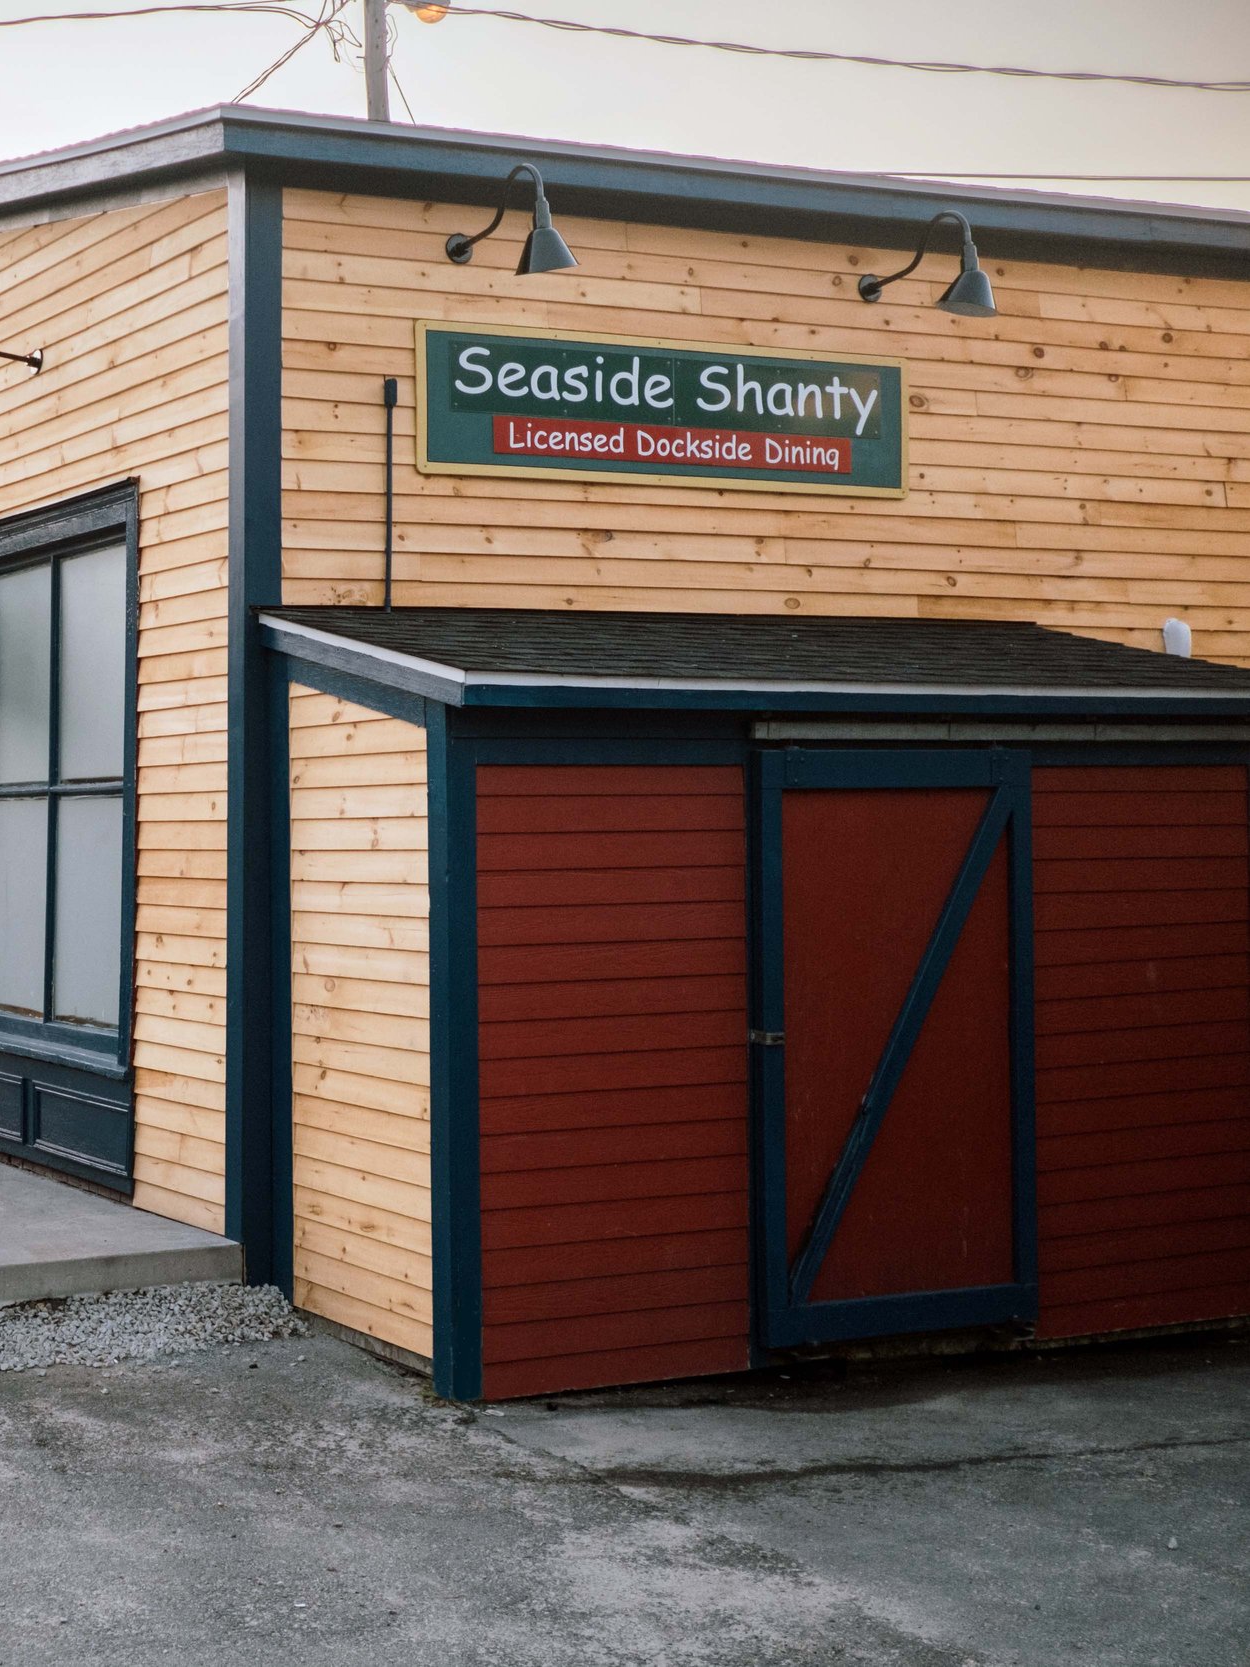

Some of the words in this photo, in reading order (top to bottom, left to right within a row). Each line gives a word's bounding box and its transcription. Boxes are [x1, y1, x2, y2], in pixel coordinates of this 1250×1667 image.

[454, 346, 674, 408] Seaside
[696, 364, 879, 436] Shanty
[508, 421, 625, 455] Licensed
[636, 429, 753, 462] Dockside
[765, 437, 841, 471] Dining
